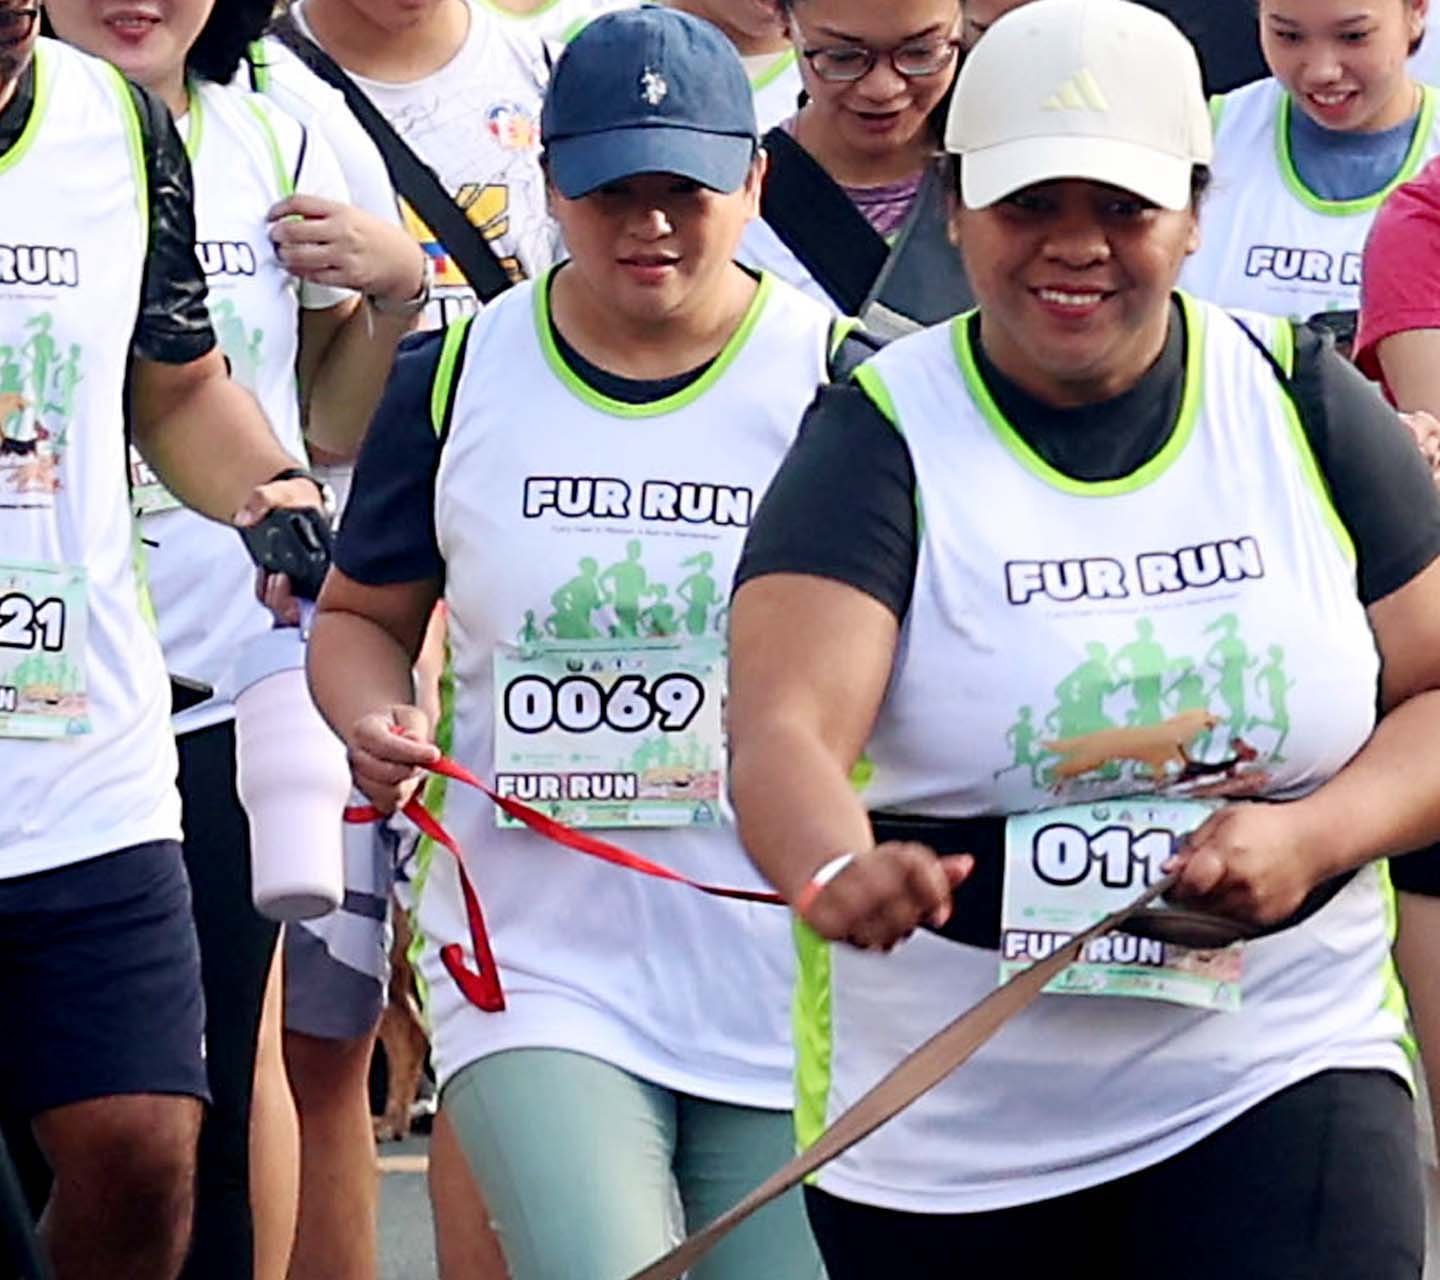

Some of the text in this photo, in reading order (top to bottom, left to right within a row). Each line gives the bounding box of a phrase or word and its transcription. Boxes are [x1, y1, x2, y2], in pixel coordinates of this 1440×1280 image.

[195, 241, 256, 276] UN
[1245, 245, 1333, 284] FUR
[523, 476, 753, 527] FUR RUN
[1005, 557, 1130, 606] FUR
[1136, 535, 1265, 596] RUN
[504, 672, 705, 734] 0069
[495, 773, 638, 801] FUR RUN
[1032, 822, 1175, 889] 011
[1086, 930, 1166, 967] RUN
